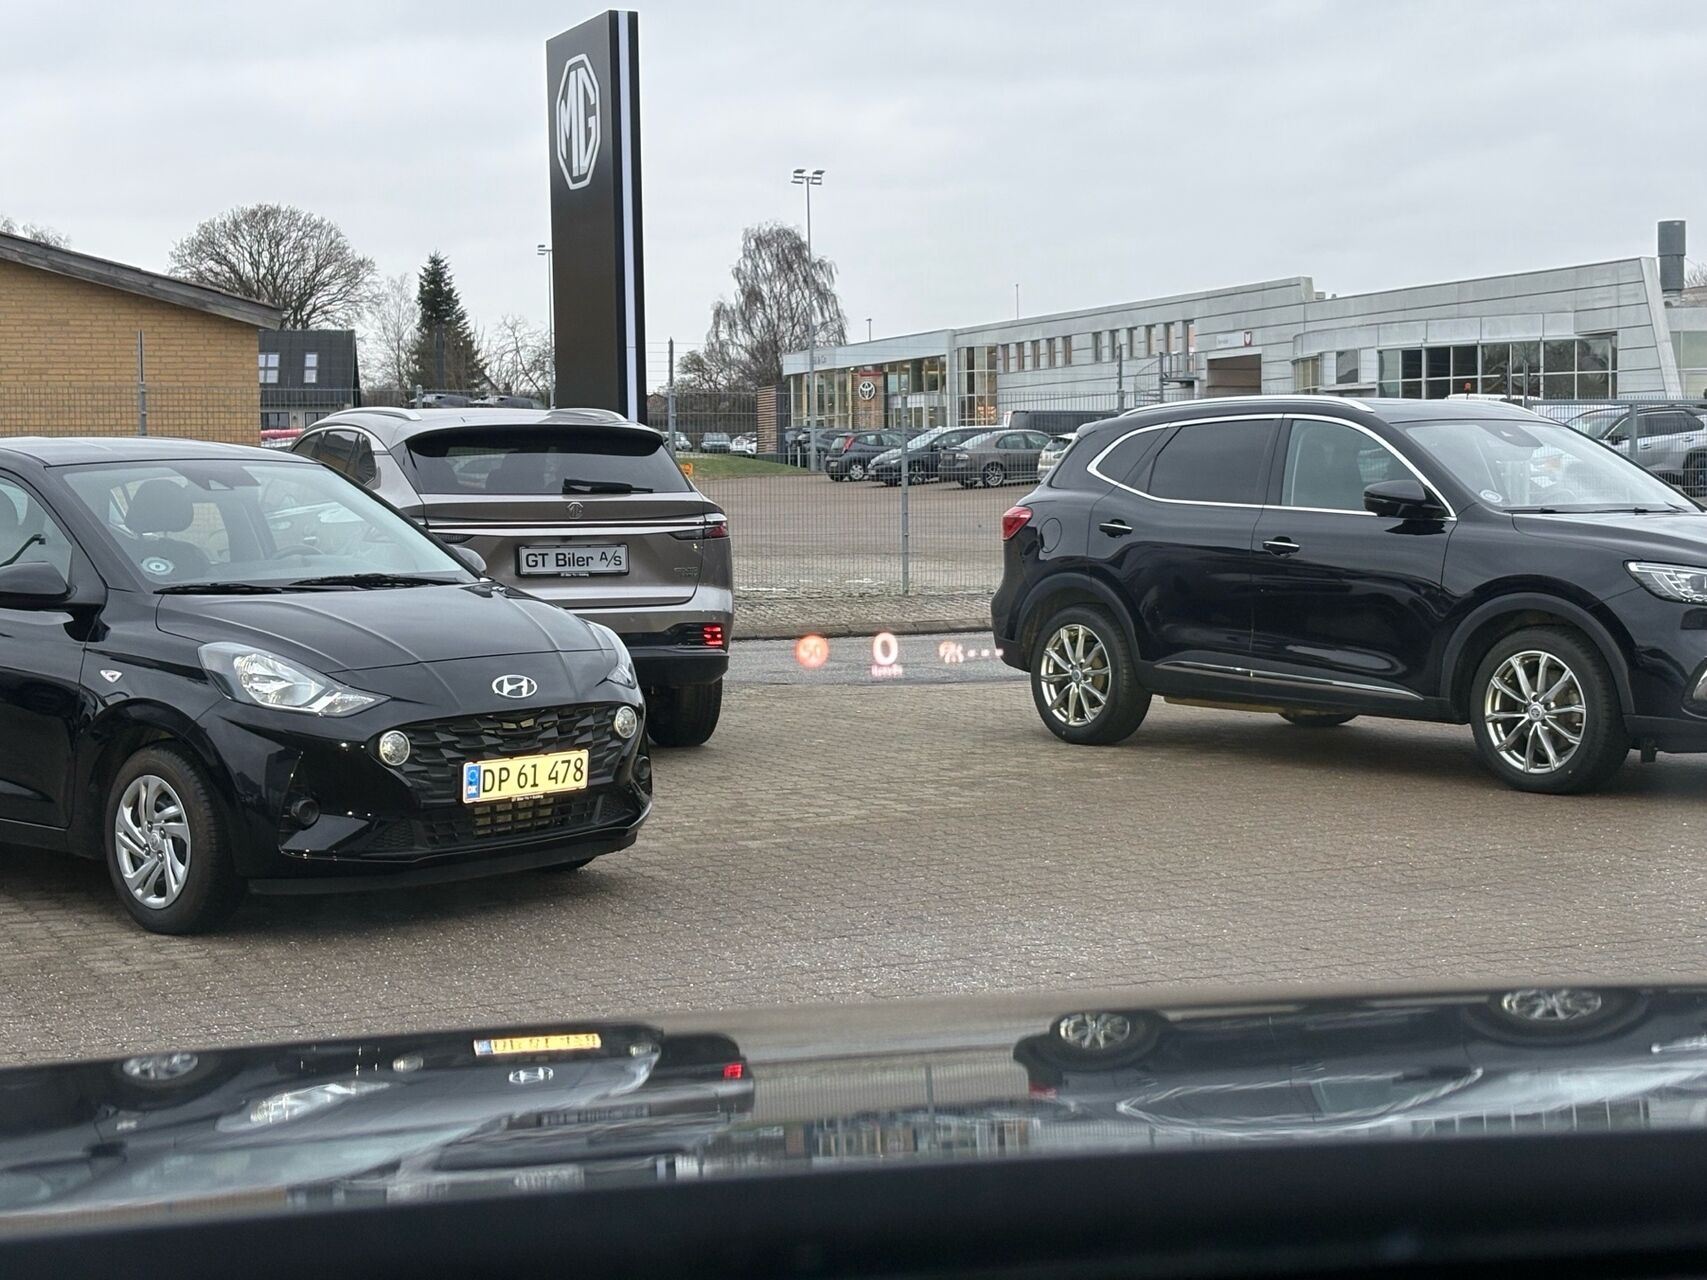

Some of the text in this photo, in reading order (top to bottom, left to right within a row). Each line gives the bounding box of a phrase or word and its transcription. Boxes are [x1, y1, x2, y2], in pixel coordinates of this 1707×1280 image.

[560, 66, 597, 178] MG
[525, 553, 549, 568] GT
[555, 552, 594, 567] Biler
[482, 757, 584, 793] DP 61 478
